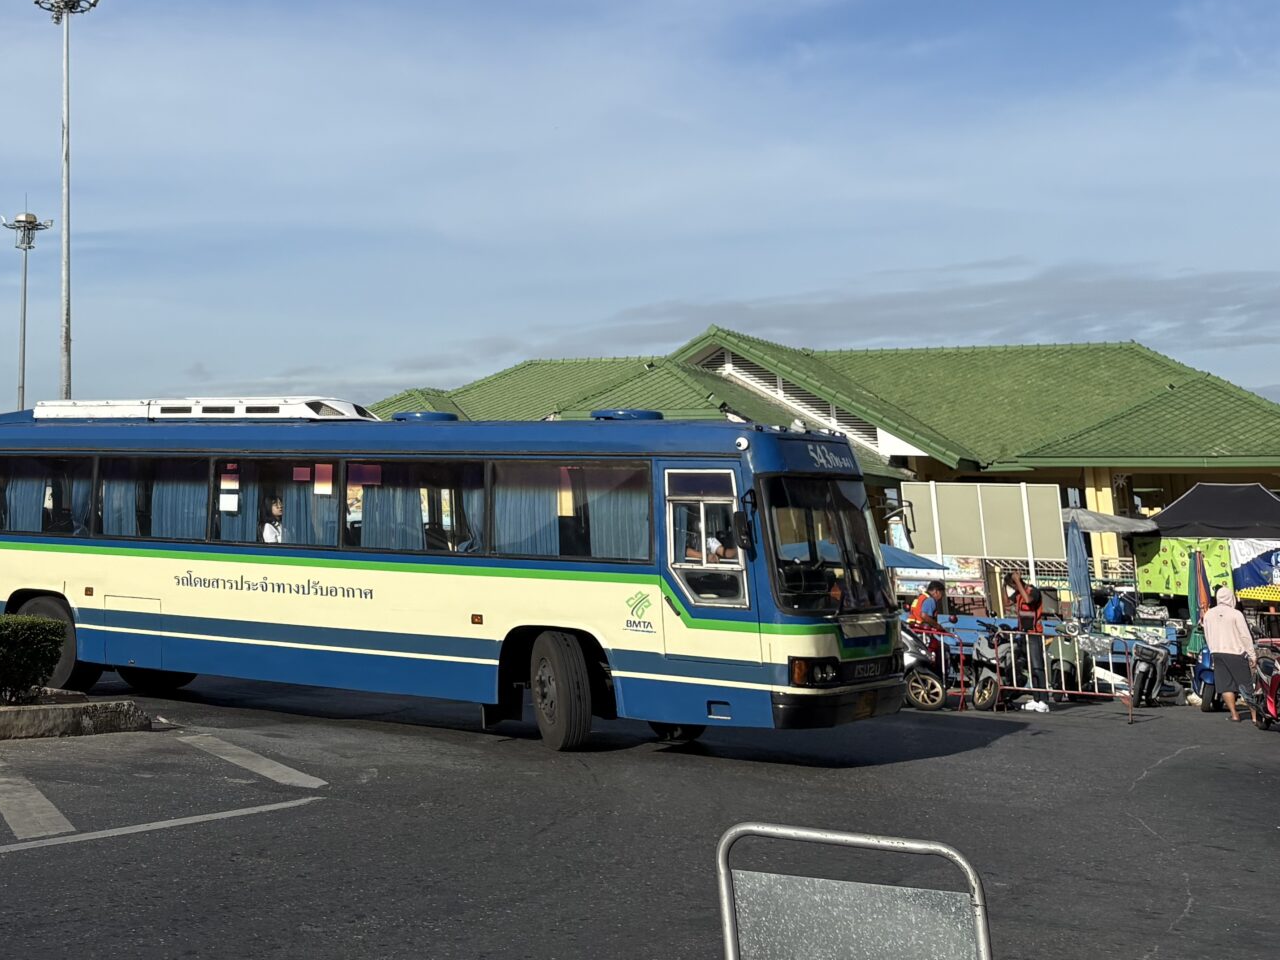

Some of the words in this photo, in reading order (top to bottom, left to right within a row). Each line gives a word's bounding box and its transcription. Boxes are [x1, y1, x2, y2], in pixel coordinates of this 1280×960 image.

[173, 571, 373, 600] รถโดยสารประจำทางปรับอากาศ
[626, 619, 653, 629] BMTA
